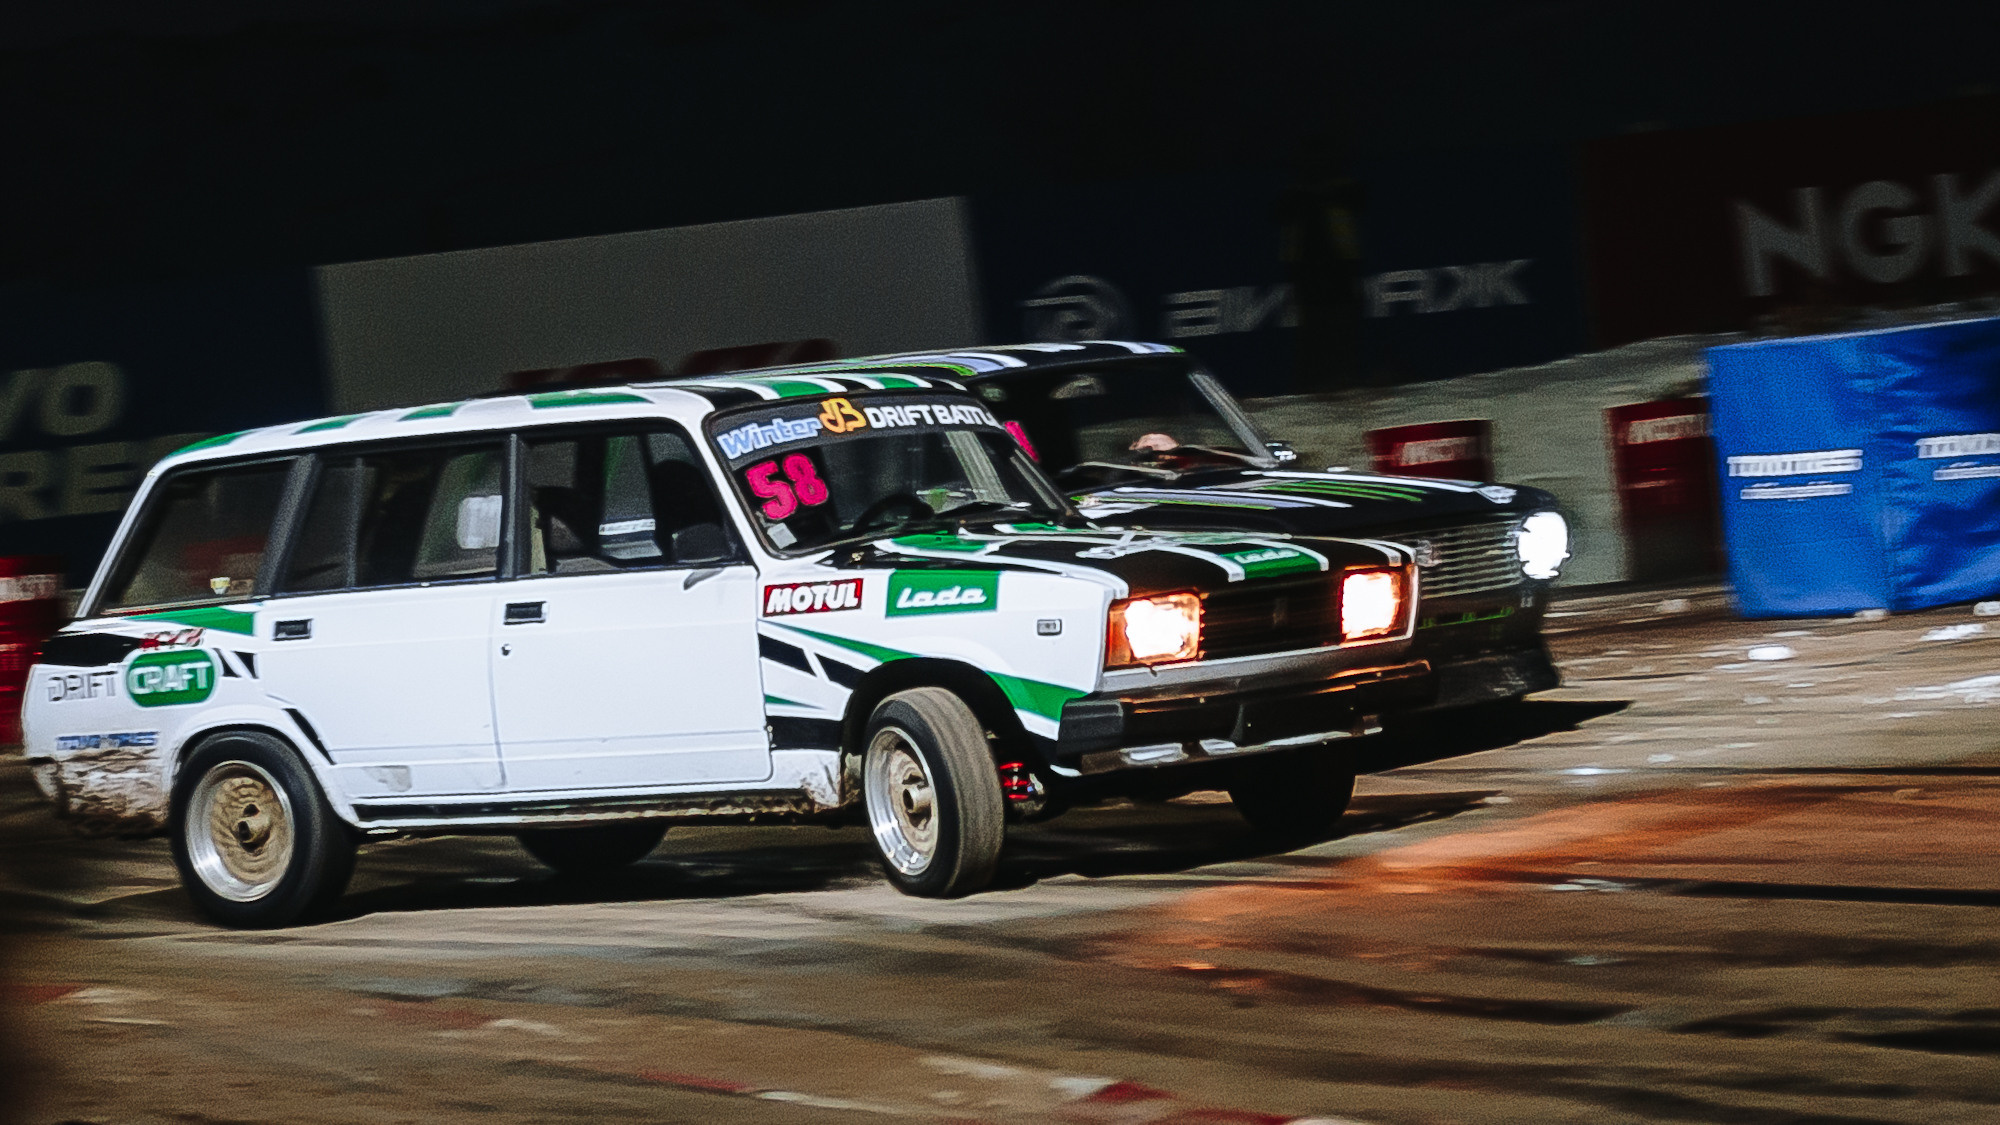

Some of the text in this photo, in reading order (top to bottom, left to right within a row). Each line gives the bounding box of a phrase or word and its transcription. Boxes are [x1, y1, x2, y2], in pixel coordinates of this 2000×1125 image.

[1733, 166, 2000, 298] NGK
[716, 417, 823, 459] Winter
[863, 404, 935, 428] DRIFT
[931, 404, 1004, 430] BATTL
[746, 452, 829, 519] 58
[765, 582, 859, 614] MOTUL
[895, 585, 988, 609] Lada
[47, 661, 213, 701] DRIFT CRAFT
